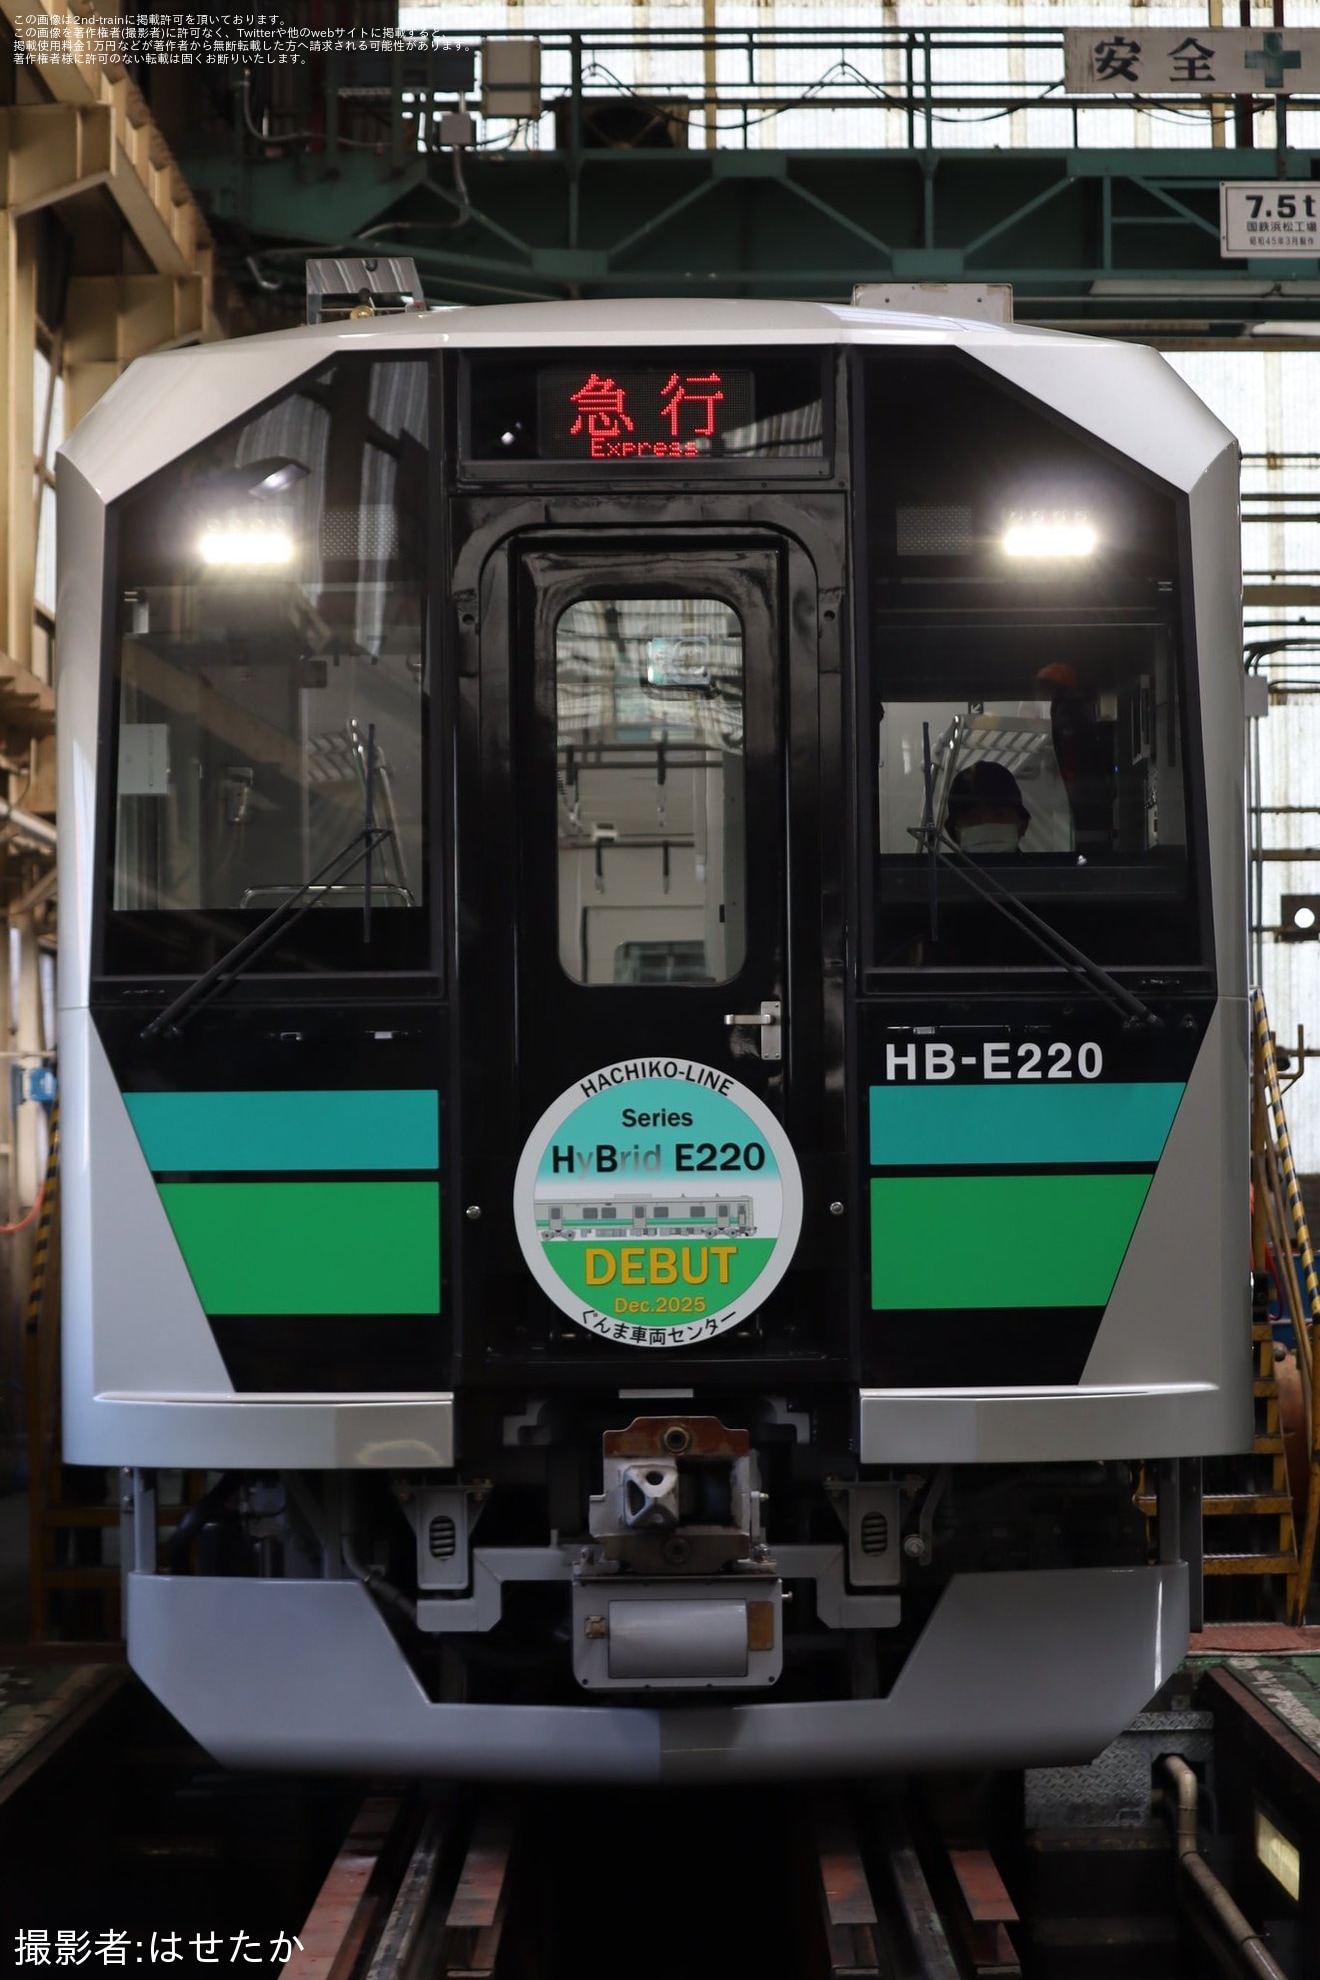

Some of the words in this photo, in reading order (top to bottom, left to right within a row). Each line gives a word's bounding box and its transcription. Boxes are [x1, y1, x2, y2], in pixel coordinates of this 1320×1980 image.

[1094, 36, 1216, 82] 安全
[570, 373, 723, 436] 急行
[591, 437, 699, 457] Express
[580, 1061, 734, 1098] HACHIKO-LINE
[886, 1042, 1103, 1080] HB-E220
[621, 1108, 693, 1128] Series
[552, 1144, 661, 1179] HyBrid
[675, 1142, 765, 1172] E220
[585, 1246, 737, 1286] DEBUT
[614, 1297, 706, 1313] Dec.2025
[582, 1309, 737, 1346] ぐんま車両センター
